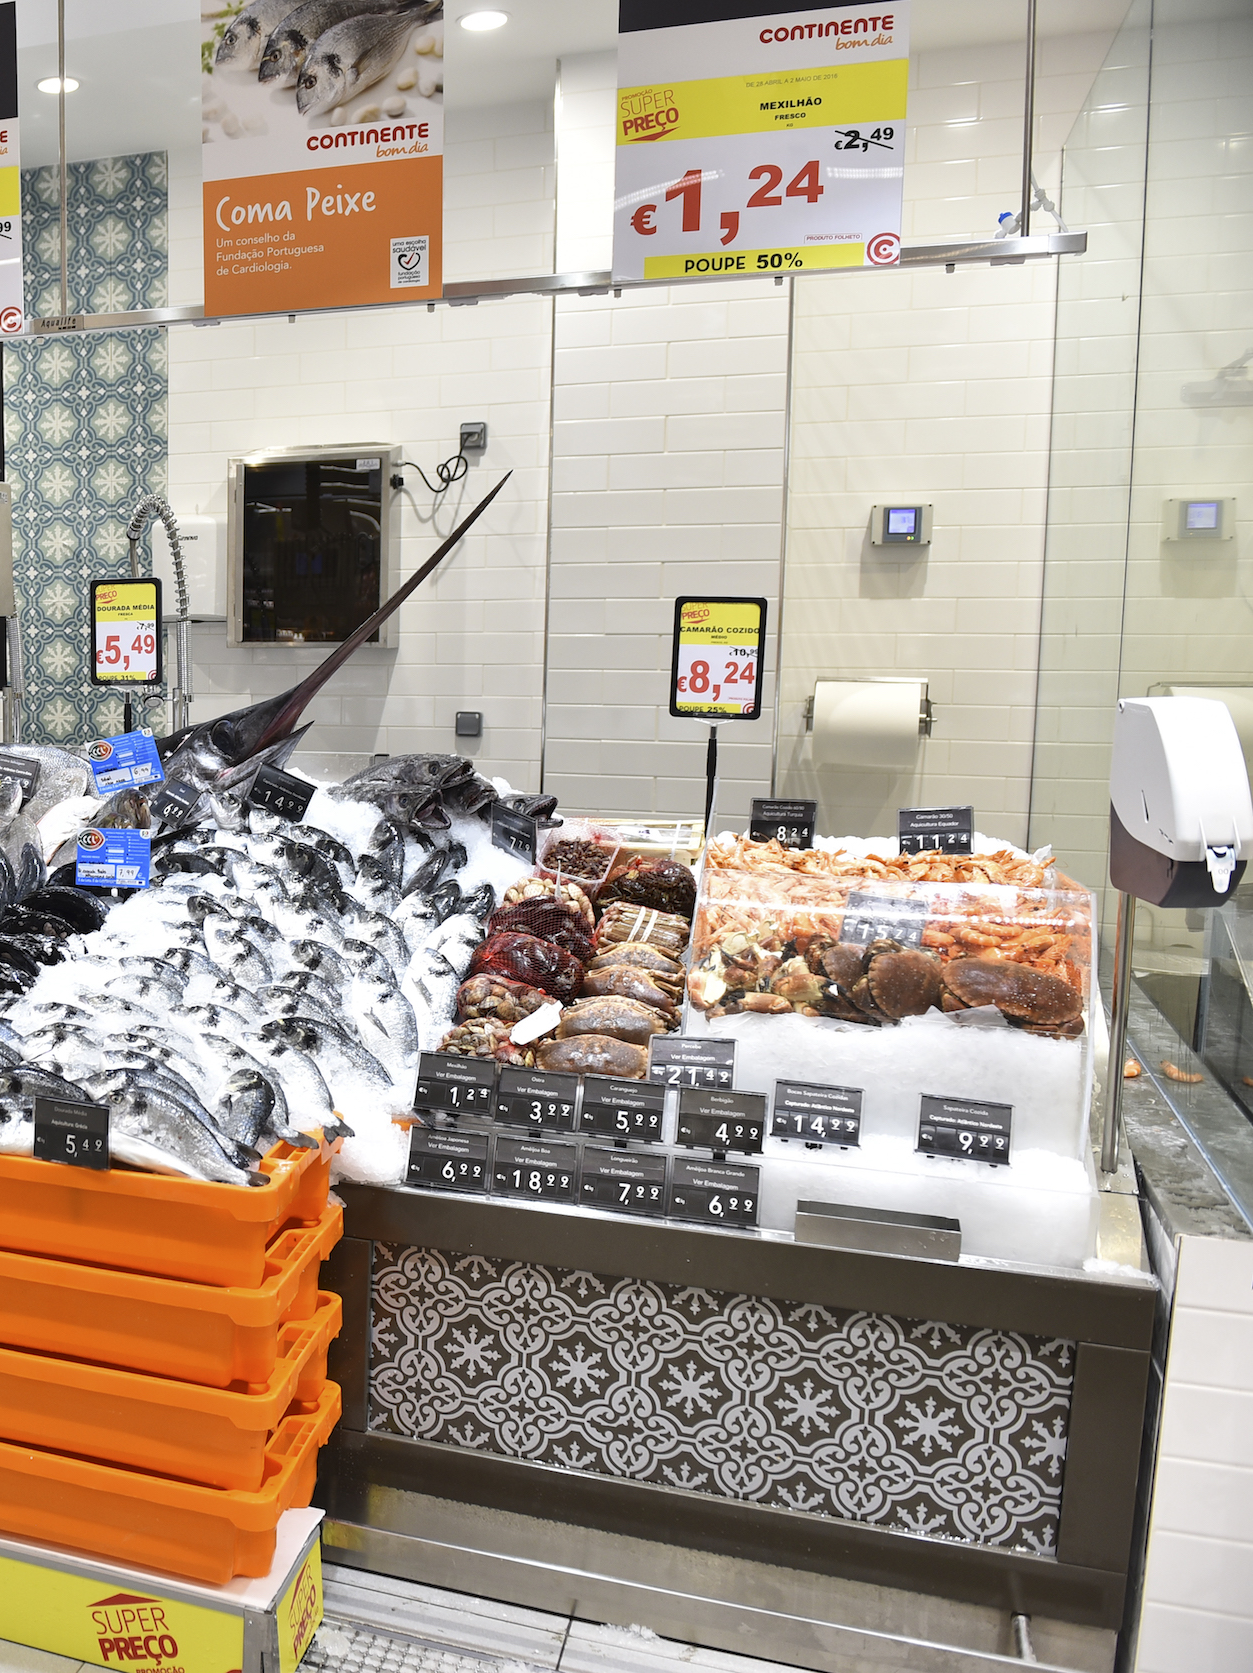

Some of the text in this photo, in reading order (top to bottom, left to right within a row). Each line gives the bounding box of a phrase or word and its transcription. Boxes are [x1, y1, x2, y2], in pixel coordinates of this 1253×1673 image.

[760, 14, 894, 43] CONTINENTE
[621, 89, 676, 118] SUPER
[760, 97, 822, 111] MEXILHÃO
[622, 107, 679, 136] PREÇO
[775, 112, 806, 121] FRESCO
[307, 123, 428, 151] CONTINENTE
[216, 184, 376, 231] Coma Peixe
[216, 231, 295, 248] Um conselho da
[216, 244, 324, 261] Fundação Portuguesa
[393, 245, 426, 253] saudável
[685, 252, 803, 272] POUPE 50%
[216, 261, 292, 276] de Cardiologia.
[96, 590, 117, 601] PREÇO
[682, 609, 710, 620] PREÇO
[682, 1054, 715, 1062] Embalagem
[446, 1062, 467, 1070] Mexilhão
[446, 1073, 477, 1082] Embalagem
[527, 1088, 558, 1097] Embalagem
[610, 1085, 638, 1094] Caranguejo
[612, 1097, 645, 1107] Embalagem
[710, 1096, 734, 1105] Berbigão
[711, 1108, 745, 1118] Embalagem
[943, 1105, 969, 1113] Sapateira
[438, 1143, 470, 1153] Embalagem
[526, 1158, 557, 1167] Embalagem
[610, 1155, 638, 1164] Longueirão
[611, 1168, 644, 1178] Embalagem
[706, 1167, 725, 1175] Branca
[704, 1180, 739, 1190] Embalagem
[91, 1606, 170, 1636] SUPER
[98, 1633, 178, 1666] PREÇO
